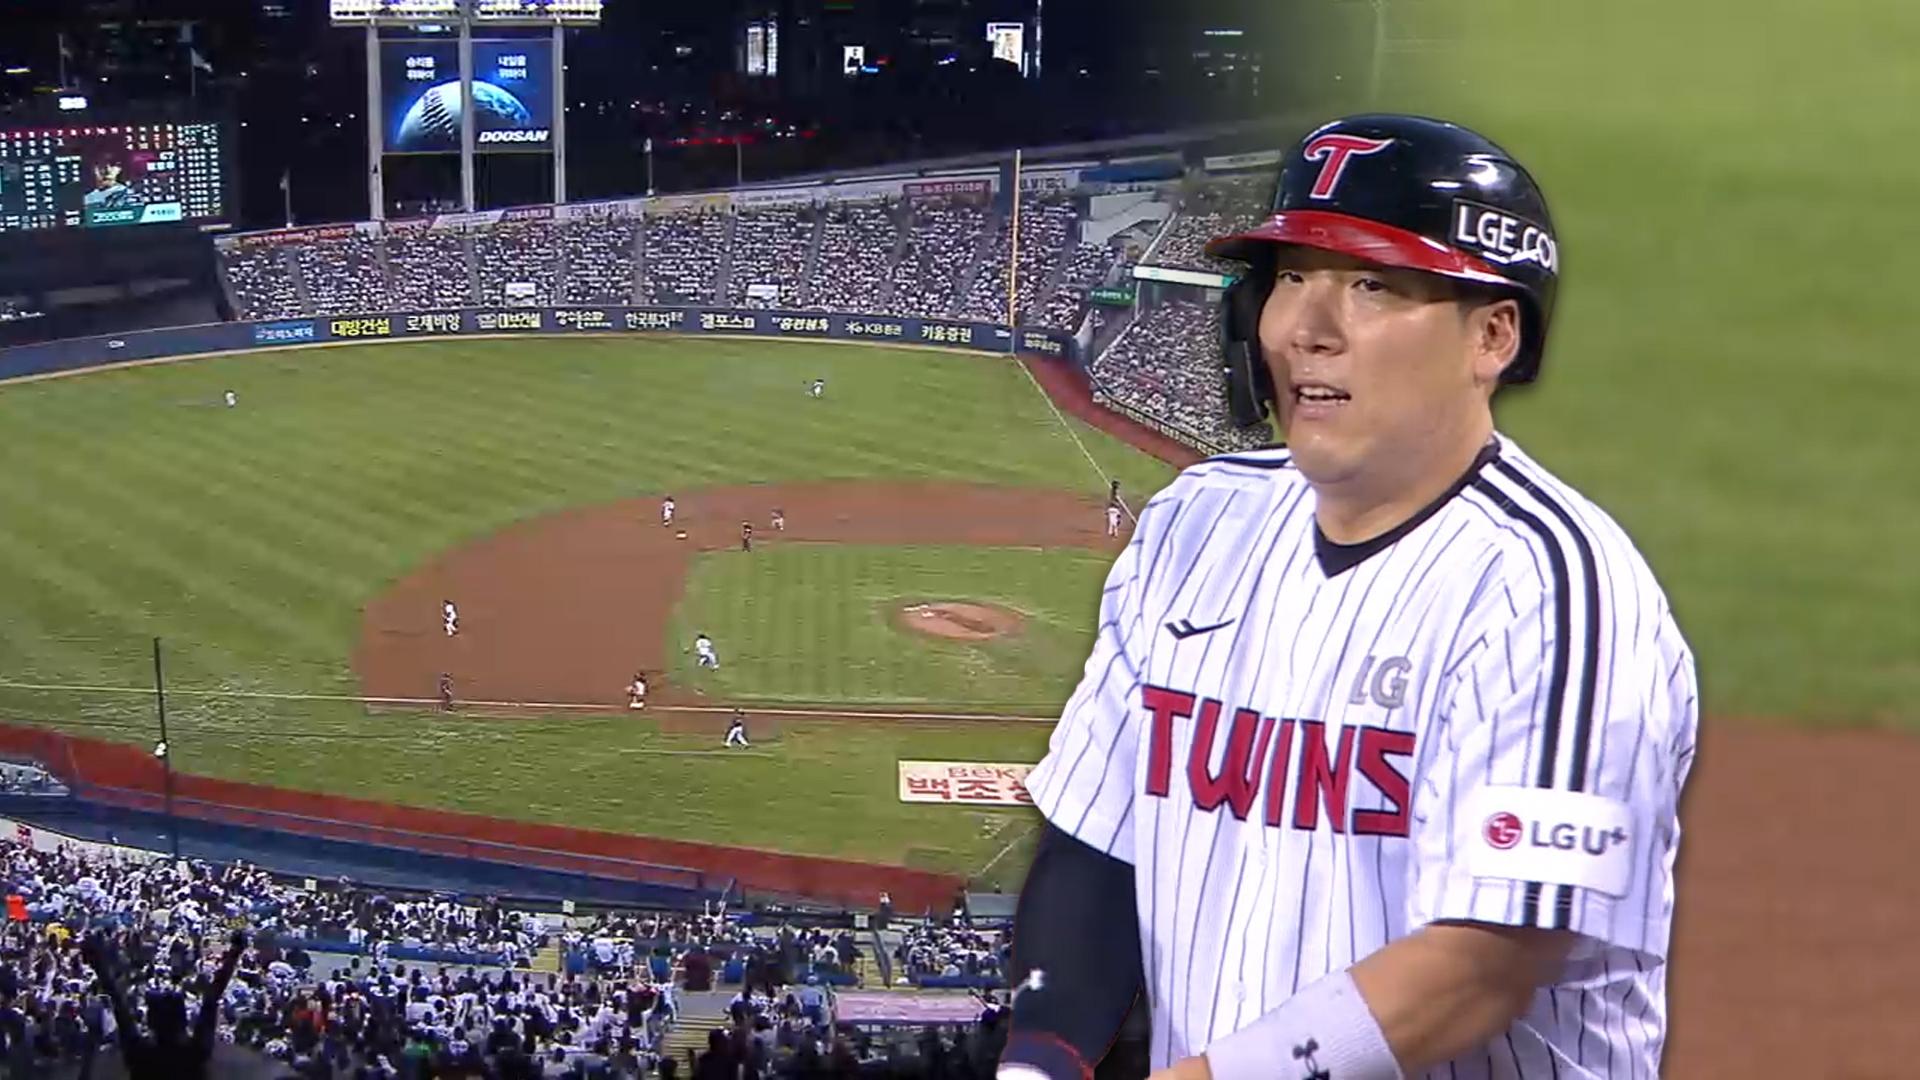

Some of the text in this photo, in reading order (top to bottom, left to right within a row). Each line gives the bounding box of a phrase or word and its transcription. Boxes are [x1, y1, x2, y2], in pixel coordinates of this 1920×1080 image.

[479, 130, 548, 143] DOOSAN
[1303, 134, 1394, 200] T
[331, 318, 390, 336] 대방건설
[406, 313, 460, 331] 로제비앙
[1349, 655, 1412, 709] LG
[1142, 683, 1416, 838] TWINS
